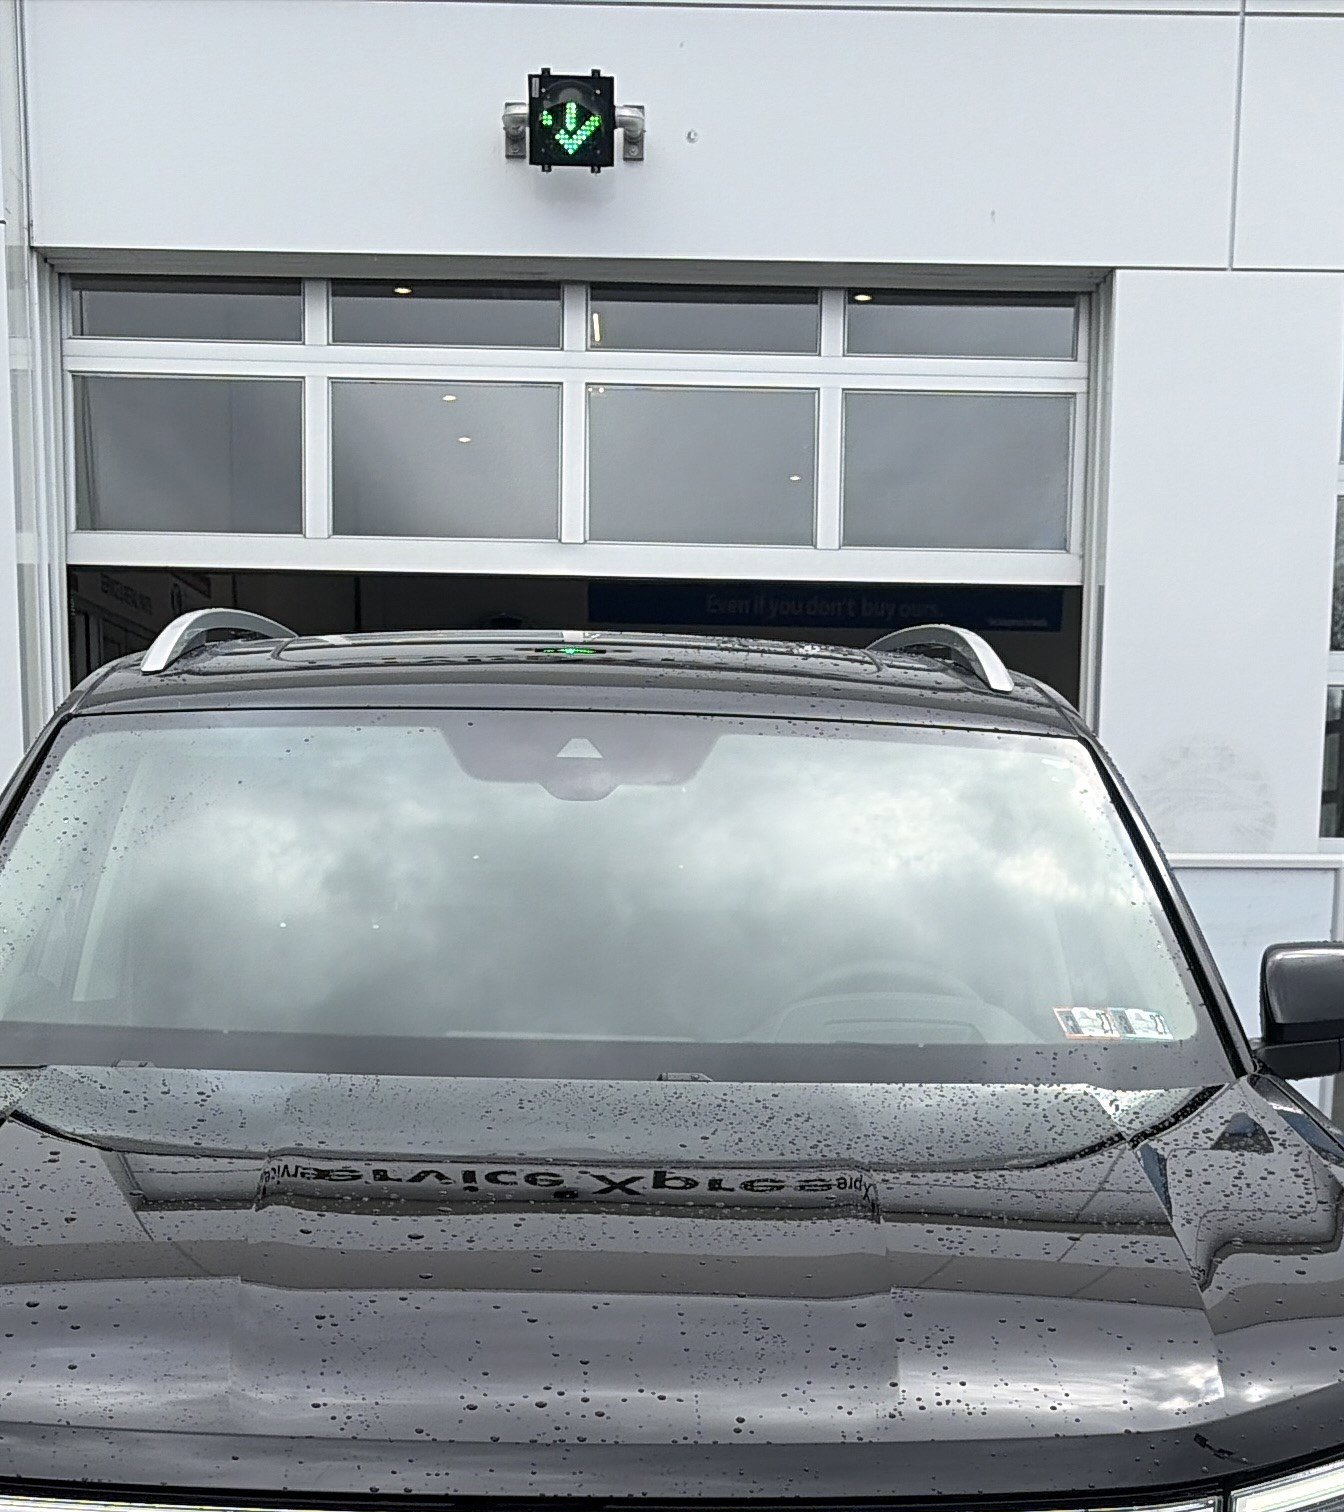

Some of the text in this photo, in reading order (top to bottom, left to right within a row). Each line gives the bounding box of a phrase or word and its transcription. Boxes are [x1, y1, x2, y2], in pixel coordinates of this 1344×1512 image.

[706, 594, 750, 614] Even
[753, 593, 765, 614] if
[768, 601, 801, 618] you
[861, 598, 896, 621] buy
